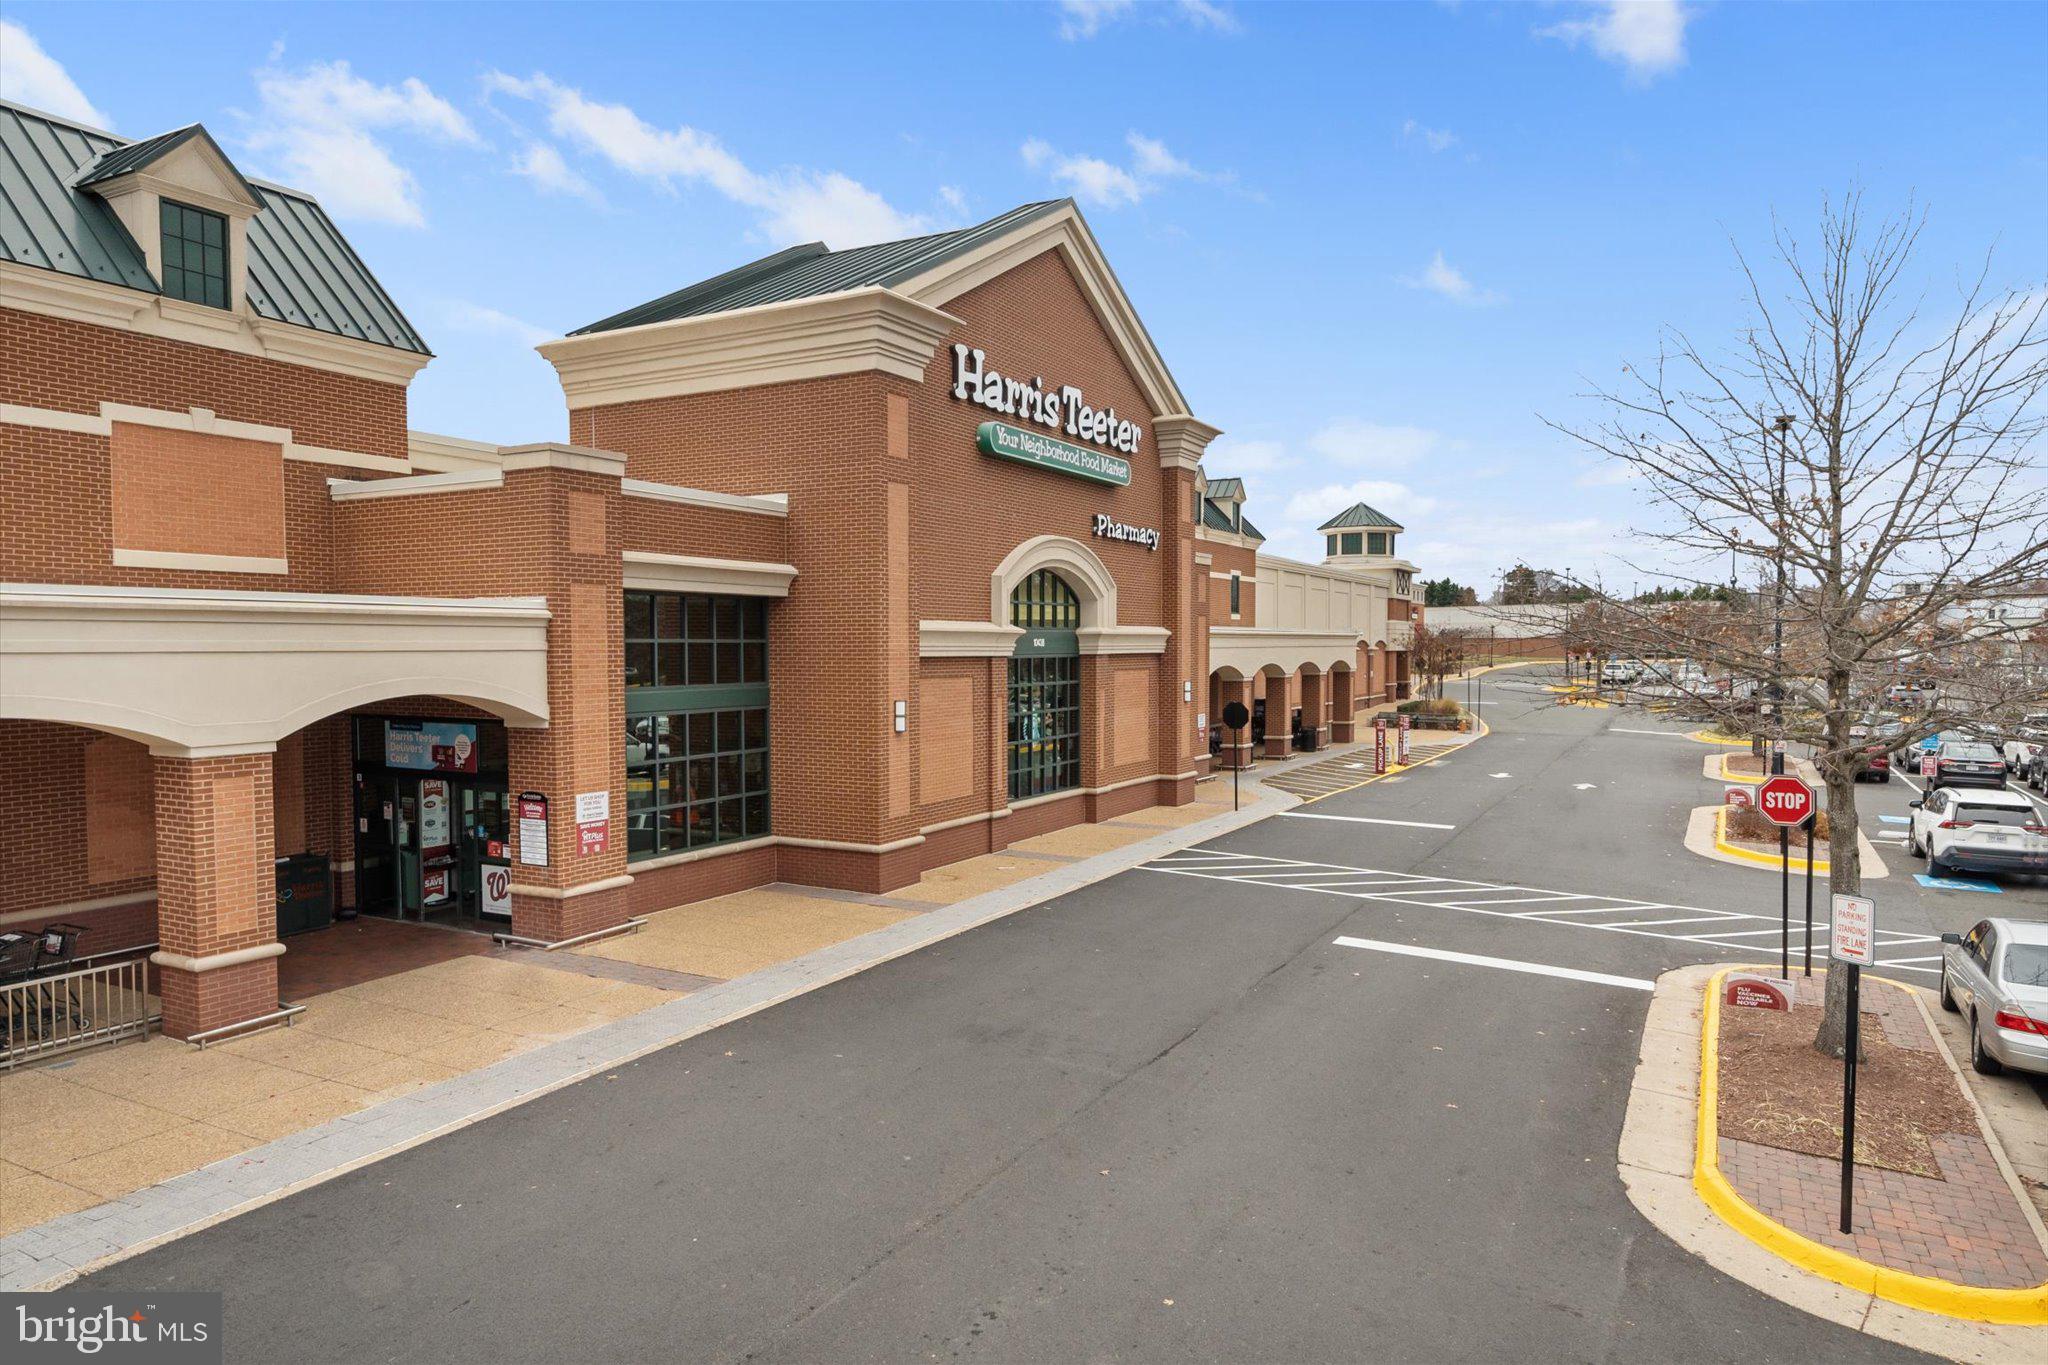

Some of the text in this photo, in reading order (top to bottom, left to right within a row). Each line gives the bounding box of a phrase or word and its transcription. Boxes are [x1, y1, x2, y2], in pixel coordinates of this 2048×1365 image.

[954, 343, 1142, 453] Harris Teeter
[996, 425, 1127, 479] Your Neighborhood Food Market
[1096, 514, 1160, 550] Pharmacy
[390, 731, 440, 743] Harris Teeter
[390, 743, 423, 753] Delivers
[424, 781, 442, 789] SAVE
[1765, 791, 1806, 810] STOP
[424, 877, 443, 888] SAVE
[487, 869, 511, 902] W
[1847, 902, 1857, 911] NO
[1838, 910, 1867, 923] PARKING
[1837, 923, 1867, 937] STANDING
[1837, 935, 1867, 949] FIRE LANE
[1736, 995, 1774, 1004] AVAILABLE
[1737, 990, 1771, 999] VACCINES
